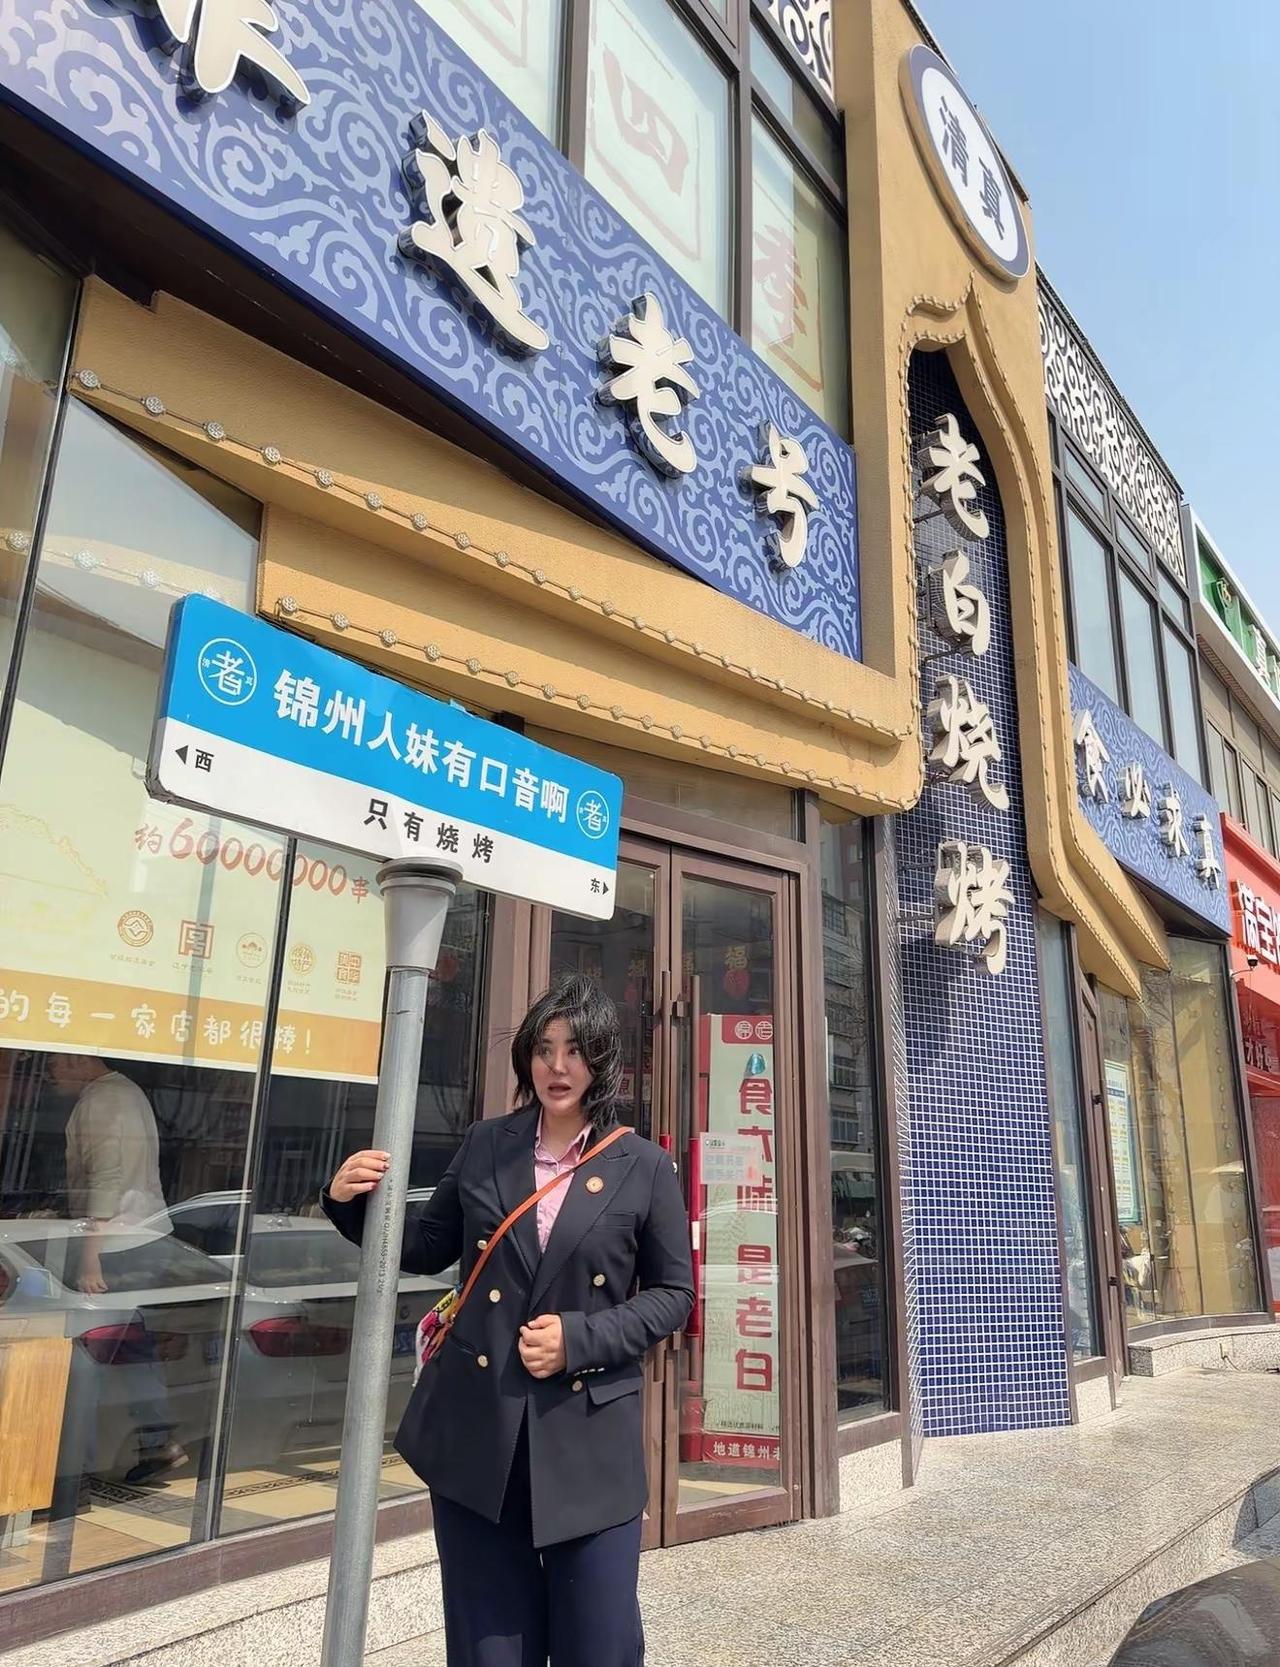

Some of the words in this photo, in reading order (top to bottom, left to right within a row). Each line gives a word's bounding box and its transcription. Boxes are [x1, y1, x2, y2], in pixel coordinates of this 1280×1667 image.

[939, 95, 1005, 241] 清真
[273, 667, 571, 824] 锦州人妹有口音啊
[924, 412, 1016, 977] 老白烧烤
[194, 748, 215, 775] 西
[363, 797, 496, 866] 只有烧烤
[589, 877, 601, 894] 东
